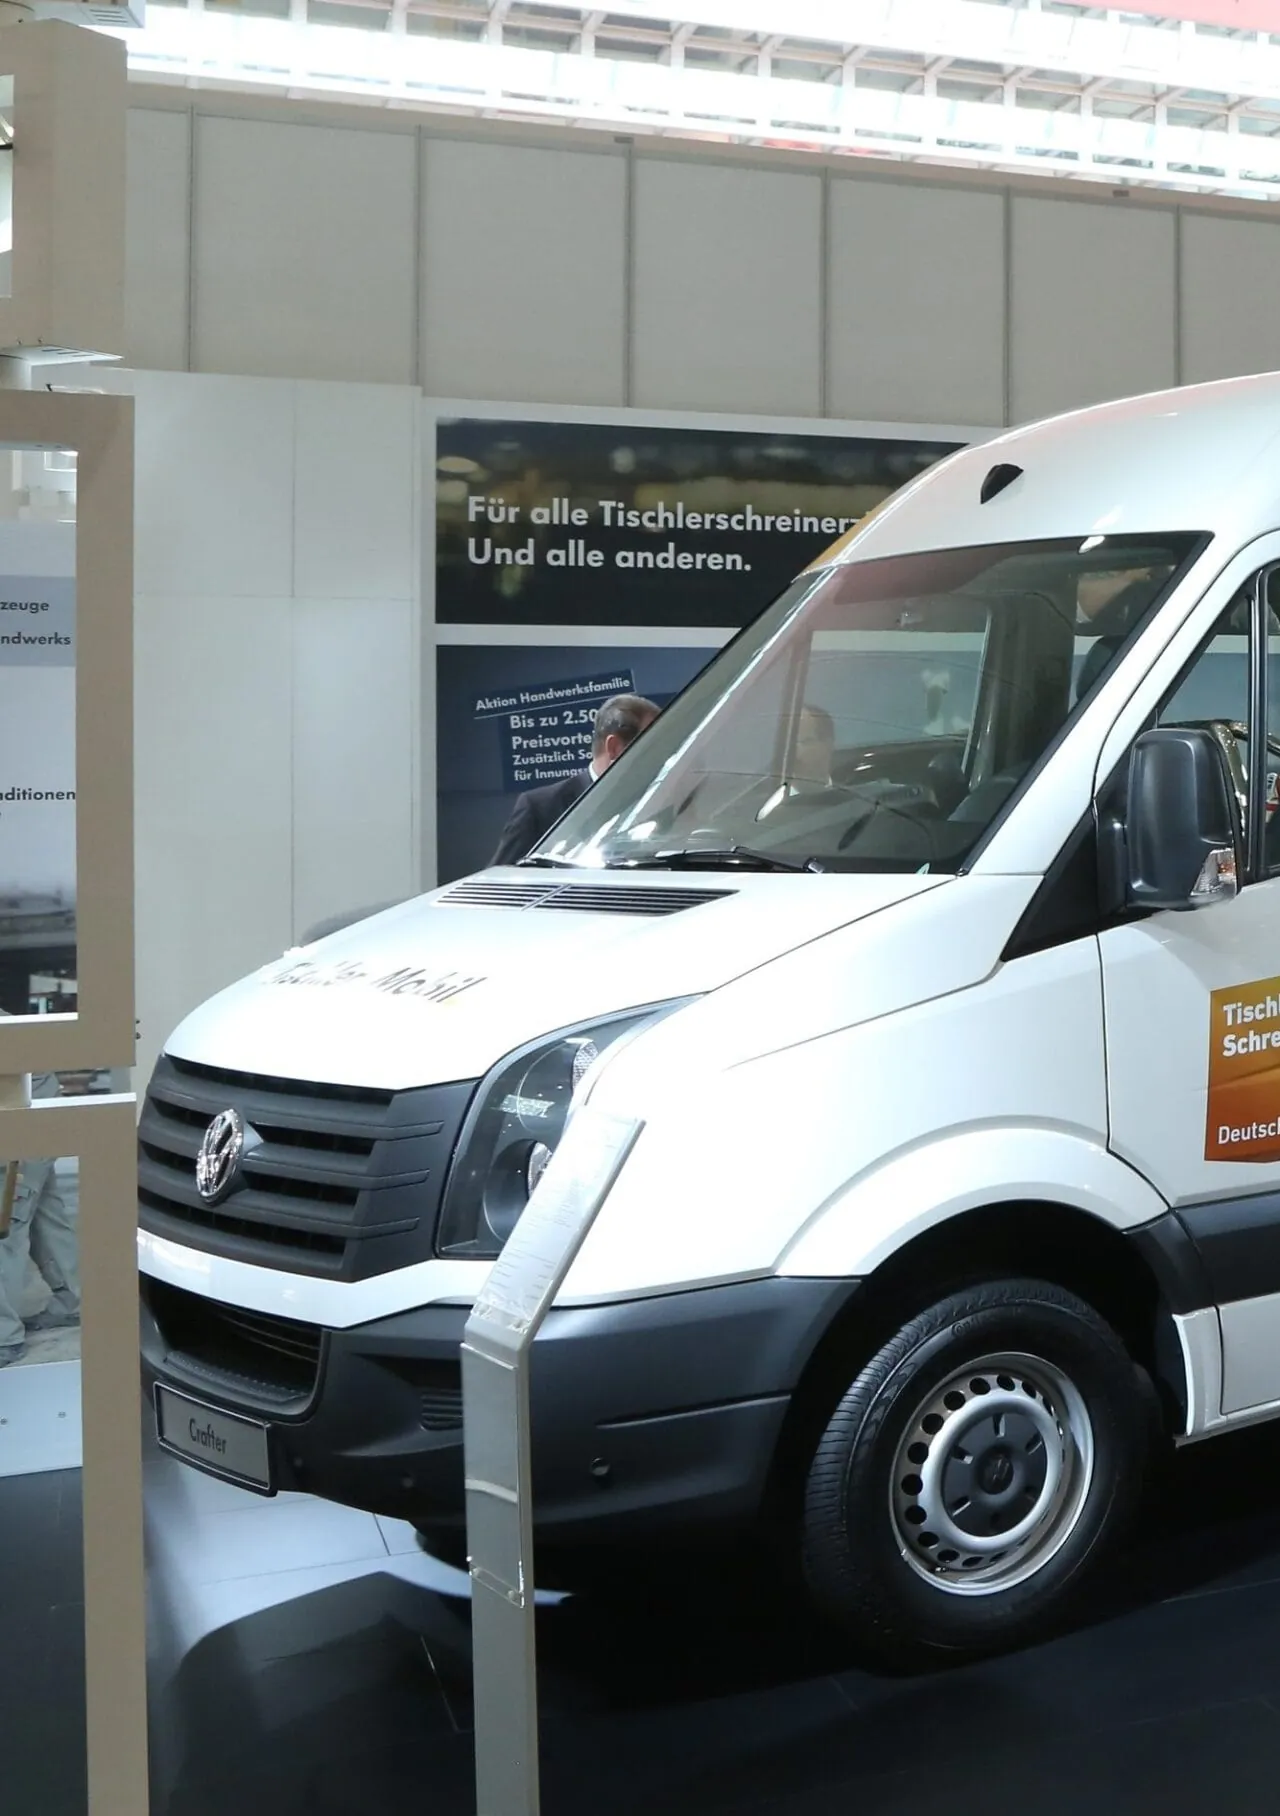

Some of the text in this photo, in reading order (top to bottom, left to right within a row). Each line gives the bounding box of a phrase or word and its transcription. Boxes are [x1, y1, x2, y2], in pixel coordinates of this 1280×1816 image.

[467, 496, 520, 524] Für
[530, 498, 589, 526] alle
[467, 538, 752, 571] Und alle anderen.
[0, 601, 50, 614] zeuge
[0, 632, 72, 645] ndwerks
[475, 677, 631, 712] Aktion Handwerksfamilie
[509, 714, 535, 730] Bis
[540, 716, 558, 728] zu
[512, 751, 575, 766] Zusätzlich
[514, 768, 531, 781] für
[0, 786, 76, 801] ditionen
[188, 1417, 227, 1455] Crafter
